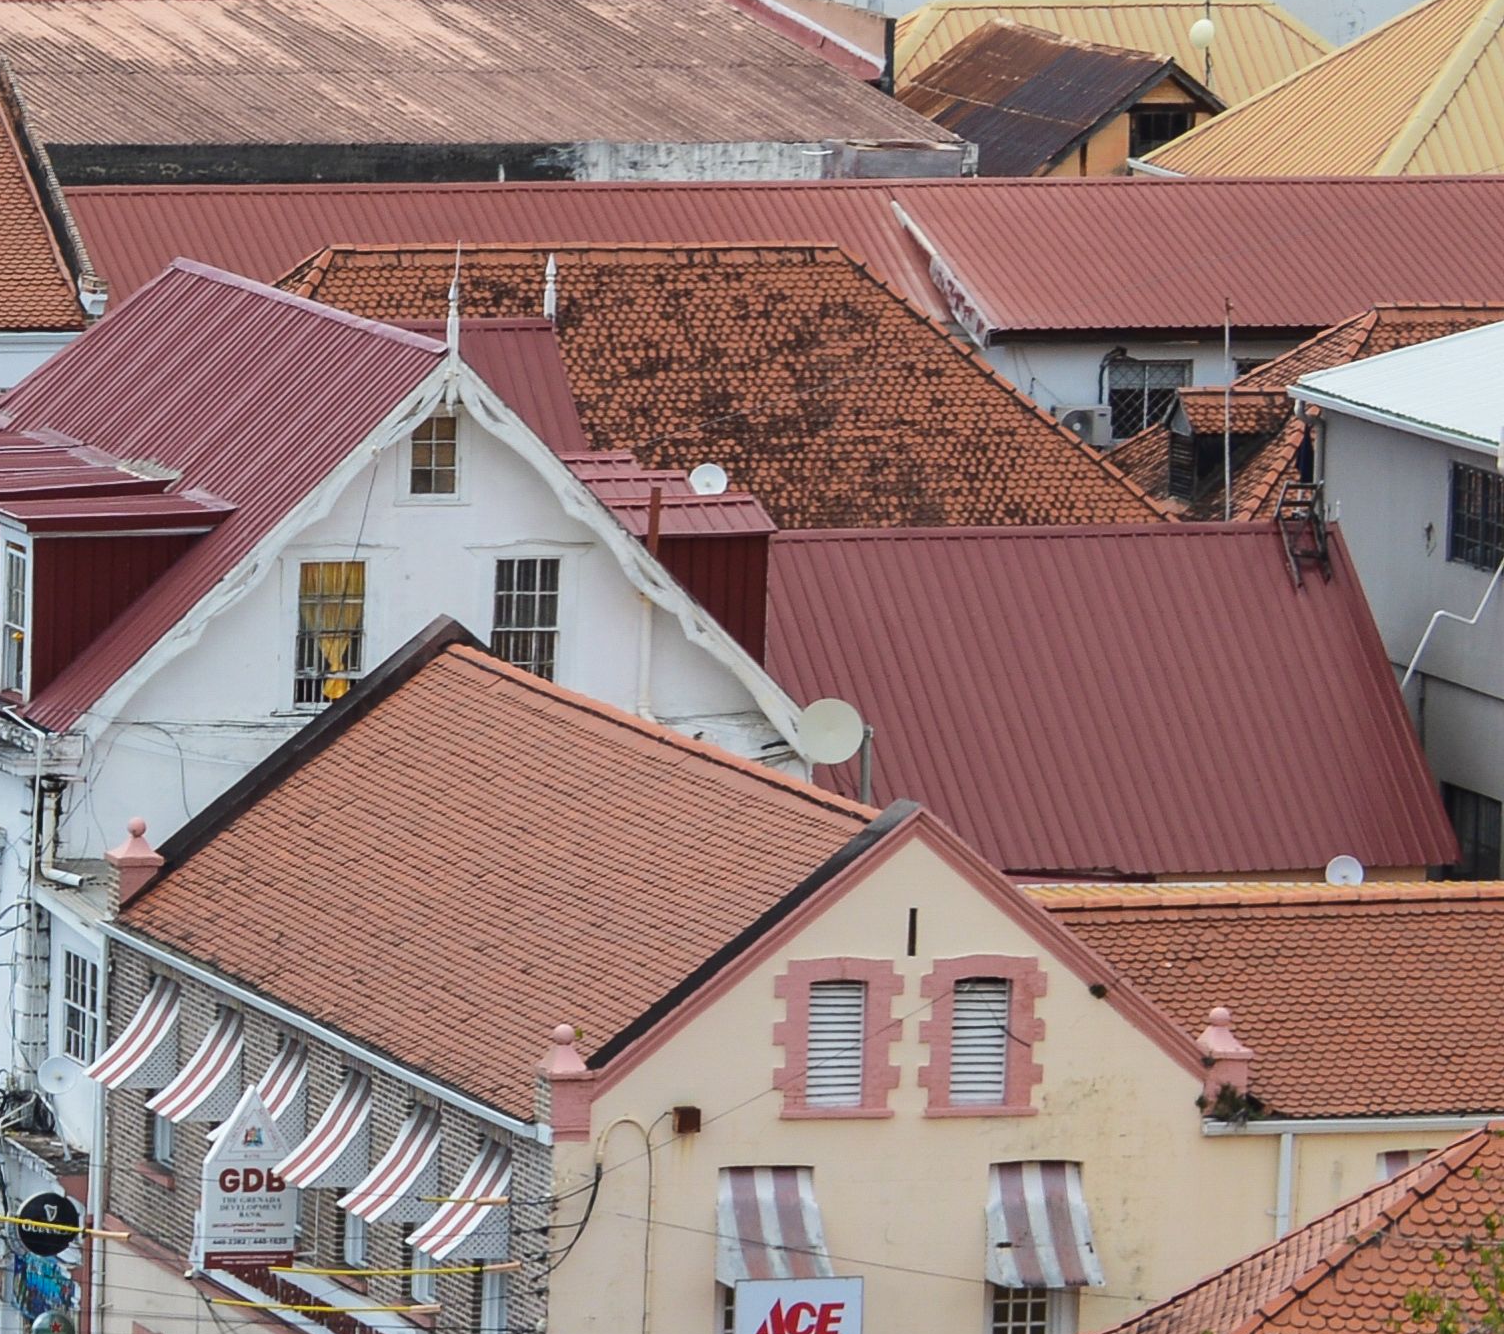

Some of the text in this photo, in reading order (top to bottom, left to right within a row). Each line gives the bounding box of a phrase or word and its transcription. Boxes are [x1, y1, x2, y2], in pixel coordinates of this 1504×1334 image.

[219, 1167, 286, 1193] GDB
[239, 1196, 281, 1204] GRENADA
[220, 1204, 283, 1212] DEVELOPMENT
